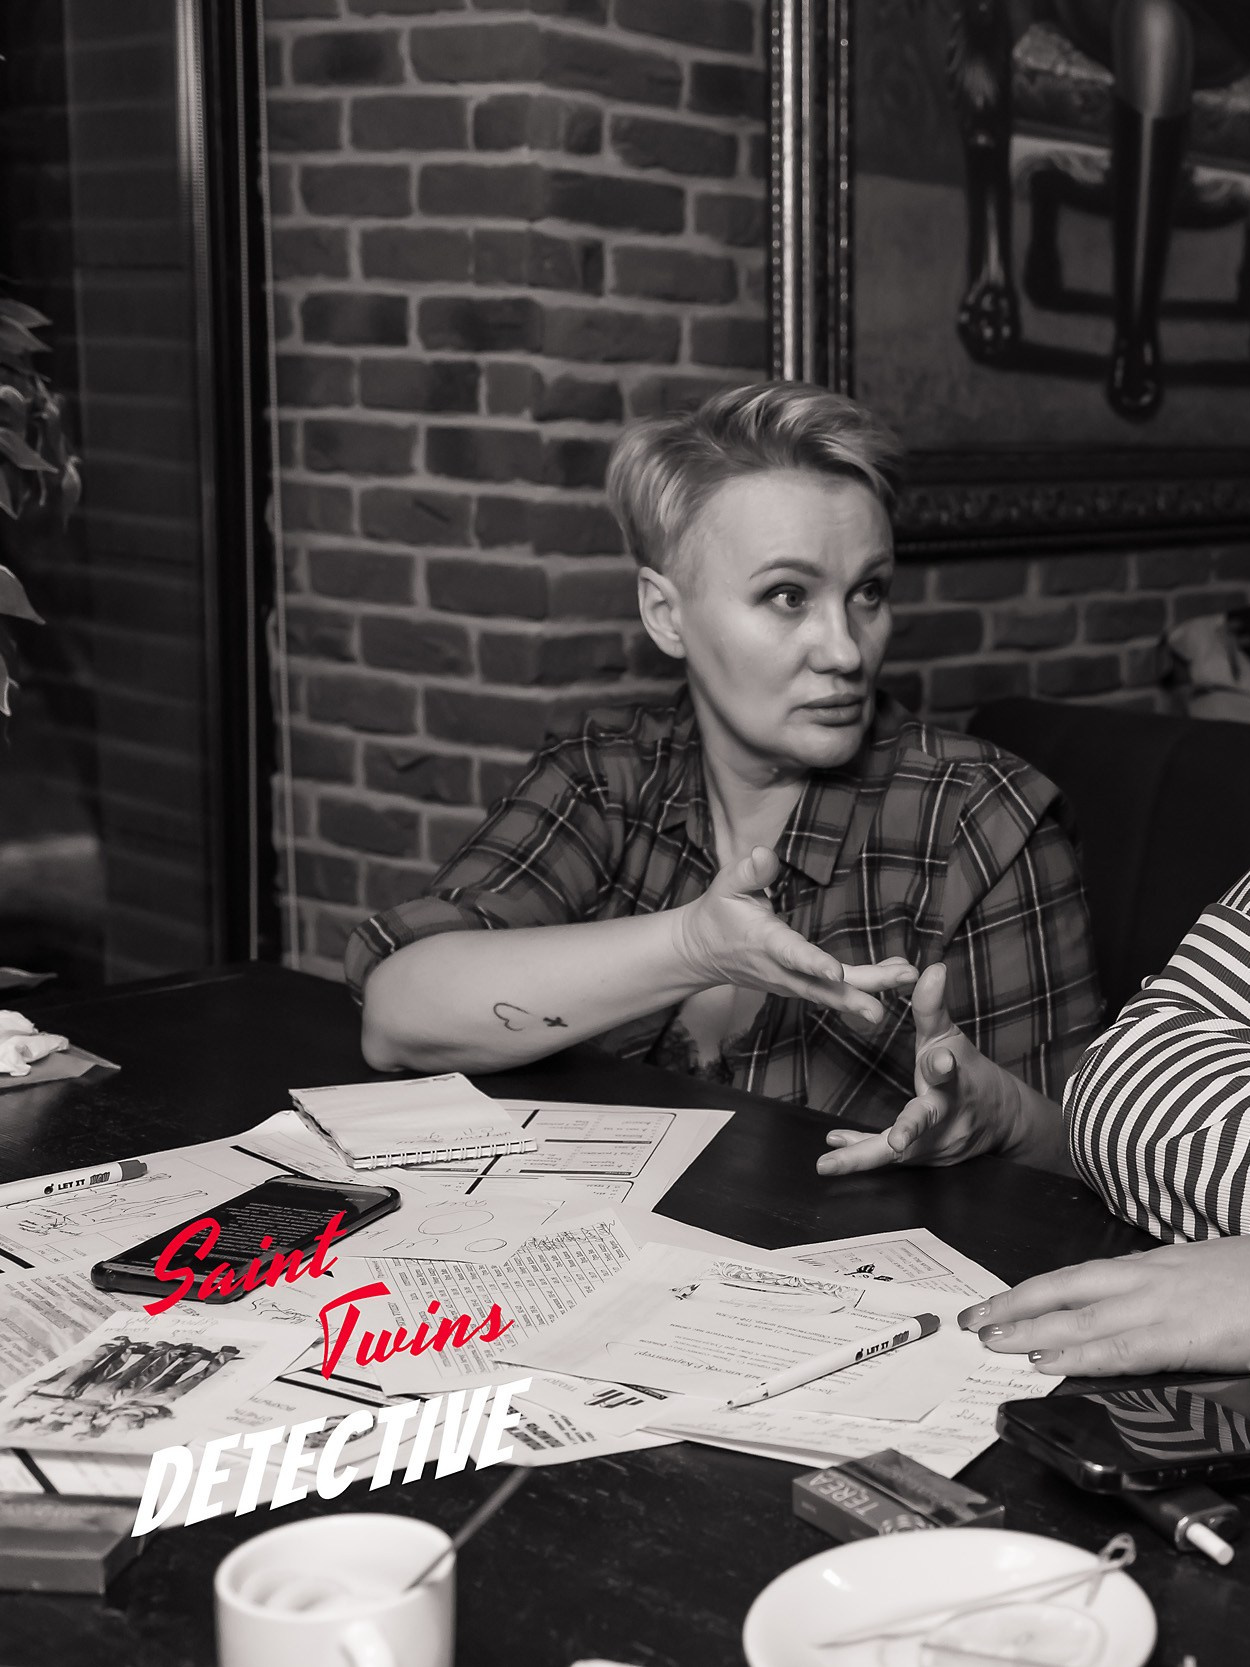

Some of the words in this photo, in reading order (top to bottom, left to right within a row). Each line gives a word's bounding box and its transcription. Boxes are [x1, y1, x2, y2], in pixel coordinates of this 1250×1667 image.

[57, 1180, 74, 1191] LET
[75, 1178, 86, 1188] IT
[866, 1344, 880, 1355] LET
[881, 1341, 890, 1350] IT
[809, 1470, 879, 1517] TEREA
